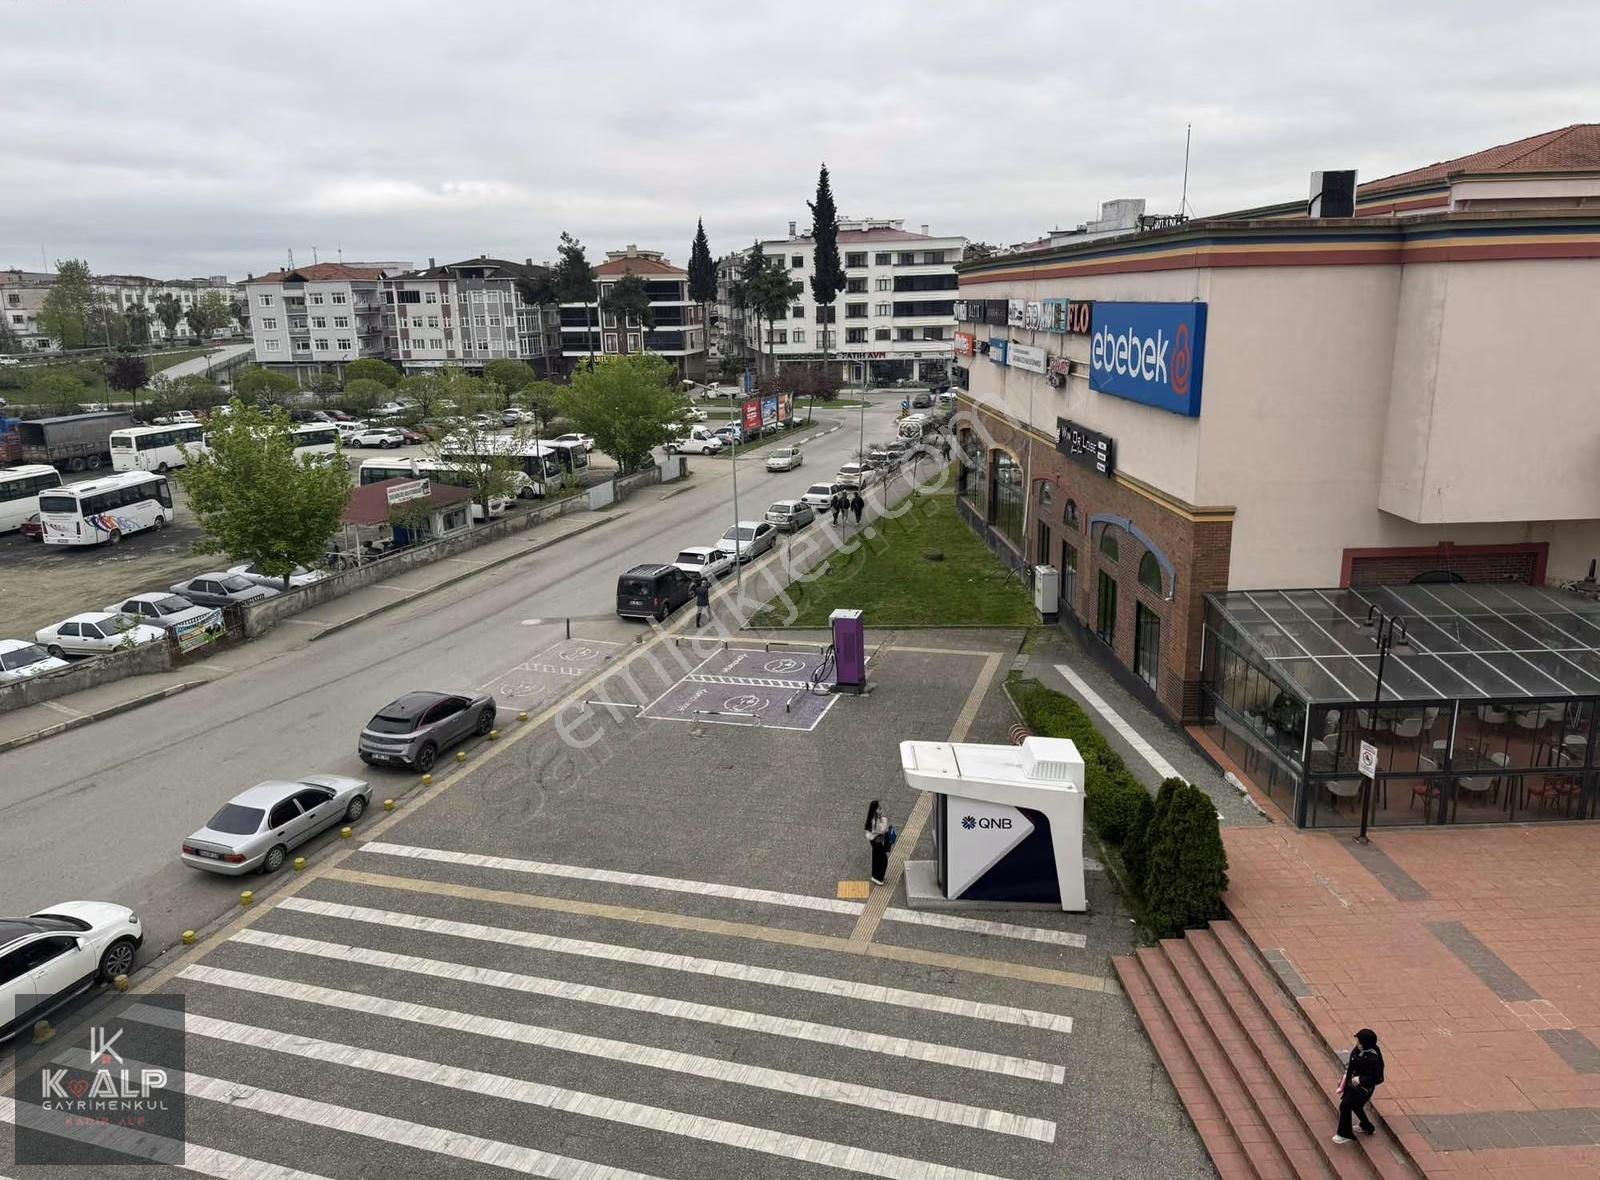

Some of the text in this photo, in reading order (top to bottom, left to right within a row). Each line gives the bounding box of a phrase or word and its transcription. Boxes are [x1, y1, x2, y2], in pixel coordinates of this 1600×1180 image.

[1068, 302, 1089, 333] FLO
[1092, 324, 1169, 384] ebebek
[979, 817, 1012, 830] QNB
